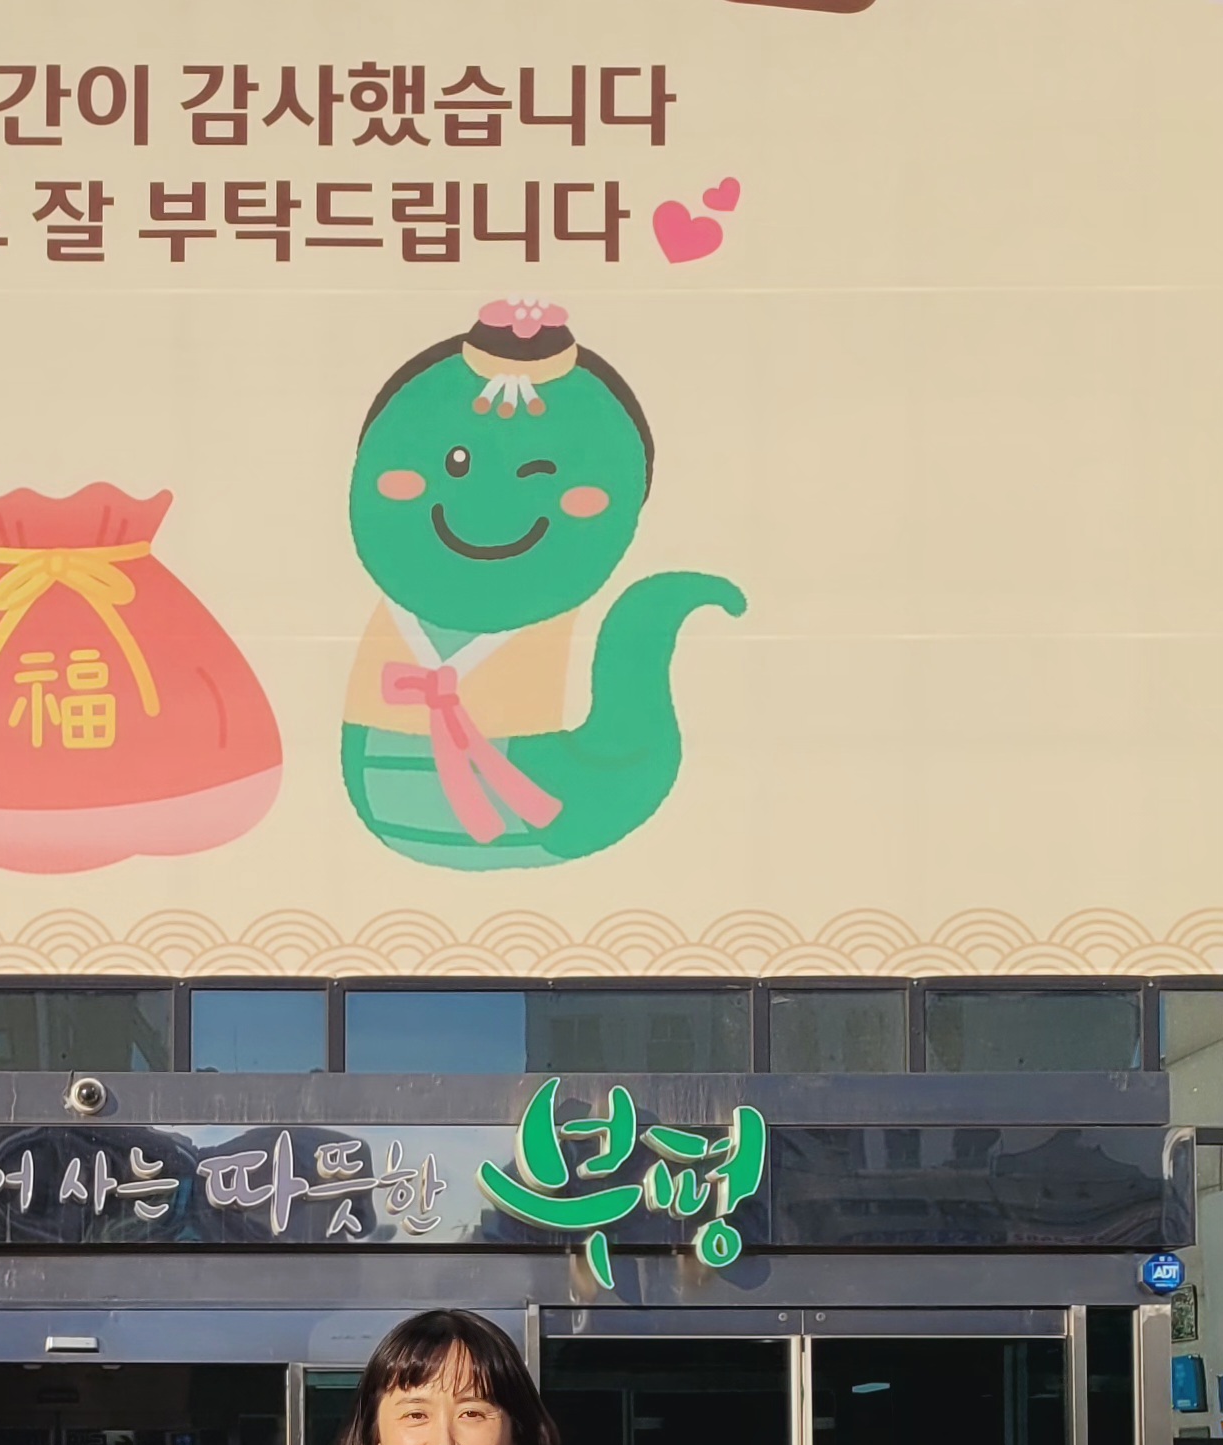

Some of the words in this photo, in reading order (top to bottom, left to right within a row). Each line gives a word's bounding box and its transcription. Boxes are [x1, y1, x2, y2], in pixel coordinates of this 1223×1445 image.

[179, 62, 675, 146] 감사했습니다
[34, 178, 113, 262] 잘
[140, 178, 631, 262] 부탁드립니다
[9, 649, 116, 748] 福
[59, 1132, 178, 1220] 사는
[203, 1128, 448, 1240] 따뜻한
[479, 1074, 765, 1290] 부평
[1153, 1265, 1179, 1279] ADT
